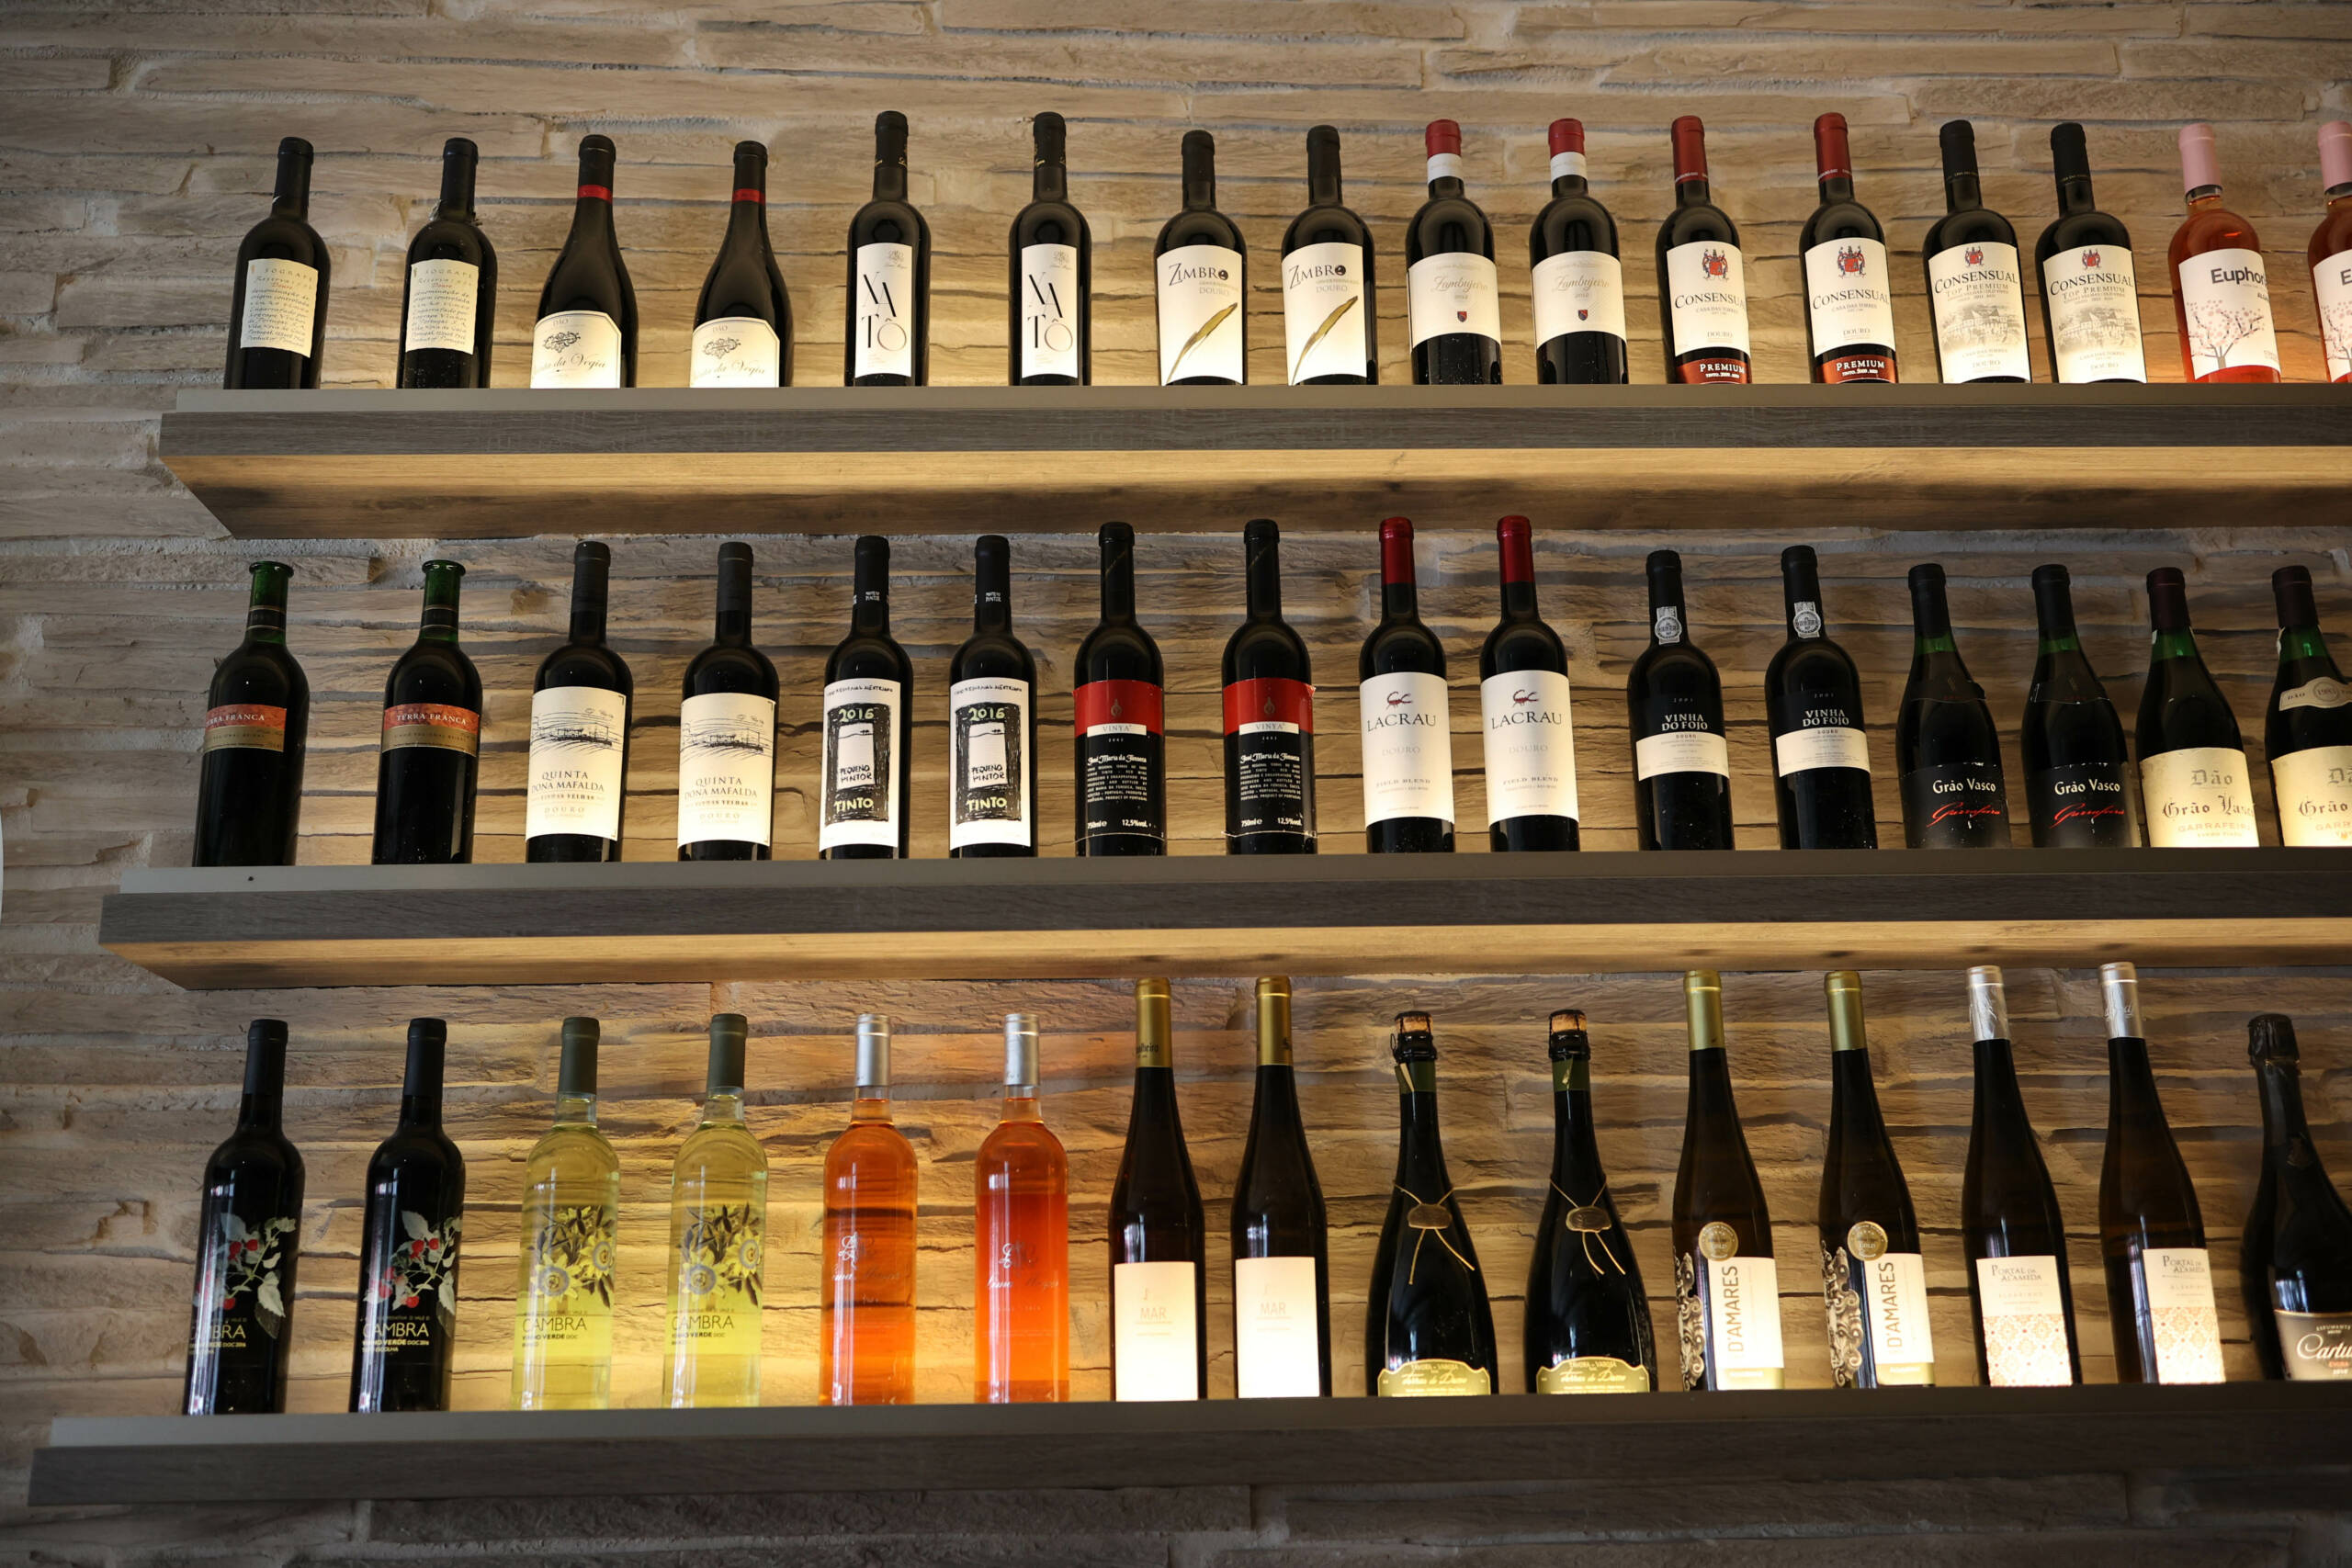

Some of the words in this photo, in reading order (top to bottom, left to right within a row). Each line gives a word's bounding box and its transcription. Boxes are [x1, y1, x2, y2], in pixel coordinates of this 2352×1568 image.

[1169, 263, 1229, 287] ZIMBRO
[1288, 264, 1347, 289] ZIMBRO
[1934, 270, 2018, 294] CONSENSUAL
[1946, 288, 1962, 298] TOP
[1966, 283, 2009, 291] PREMIUM
[2050, 273, 2134, 296] CONSENSUAL
[1813, 288, 1890, 310] CONSENSUAL
[2064, 289, 2079, 300] TOP
[1700, 363, 1745, 374] PREMIUM
[1837, 359, 1885, 372] PREMIUM
[429, 714, 467, 726] FRANCA
[838, 708, 875, 723] 2016
[968, 708, 1006, 722] 2016
[1491, 711, 1563, 730] LACRAU
[1665, 713, 1704, 723] VINHA
[1805, 709, 1845, 718] VINHA
[206, 716, 221, 727] TERRA
[1367, 713, 1436, 733] LACRAU
[1661, 721, 1680, 732] DO
[1681, 721, 1708, 731] FOJO
[1803, 717, 1821, 727] DO
[1823, 716, 1849, 726] FOJO
[1383, 746, 1420, 757] DOURO
[1509, 744, 1548, 754] DOURO
[541, 771, 589, 781] QUINTA
[840, 764, 870, 775] PEQUENO
[971, 764, 1002, 775] PEQUENO
[695, 776, 743, 786] QUINTA
[841, 773, 872, 784] PINTOR
[972, 773, 1005, 783] PINTOR
[2191, 769, 2233, 785] Dão
[531, 782, 553, 793] DONA
[557, 781, 605, 792] MAFALDA
[1932, 779, 1963, 795] Grão
[1967, 778, 1996, 793] Vasco
[2054, 780, 2086, 795] Grão
[2088, 778, 2120, 792] Vasco
[684, 789, 708, 801] DONA
[711, 788, 758, 798] MAFALDA
[833, 797, 875, 813] TINTO
[966, 796, 1007, 813] TINTO
[2163, 800, 2211, 818] Grão
[2299, 800, 2348, 817] Grão
[2162, 1256, 2195, 1268] PORTAL
[1992, 1264, 2027, 1276] PORTAL
[1721, 1266, 1745, 1353] D'AMARES
[1878, 1261, 1904, 1348] D'AMARES
[522, 1316, 588, 1333] CAMBRA
[672, 1314, 735, 1331] CAMBRA
[362, 1322, 430, 1338] CAMBRA
